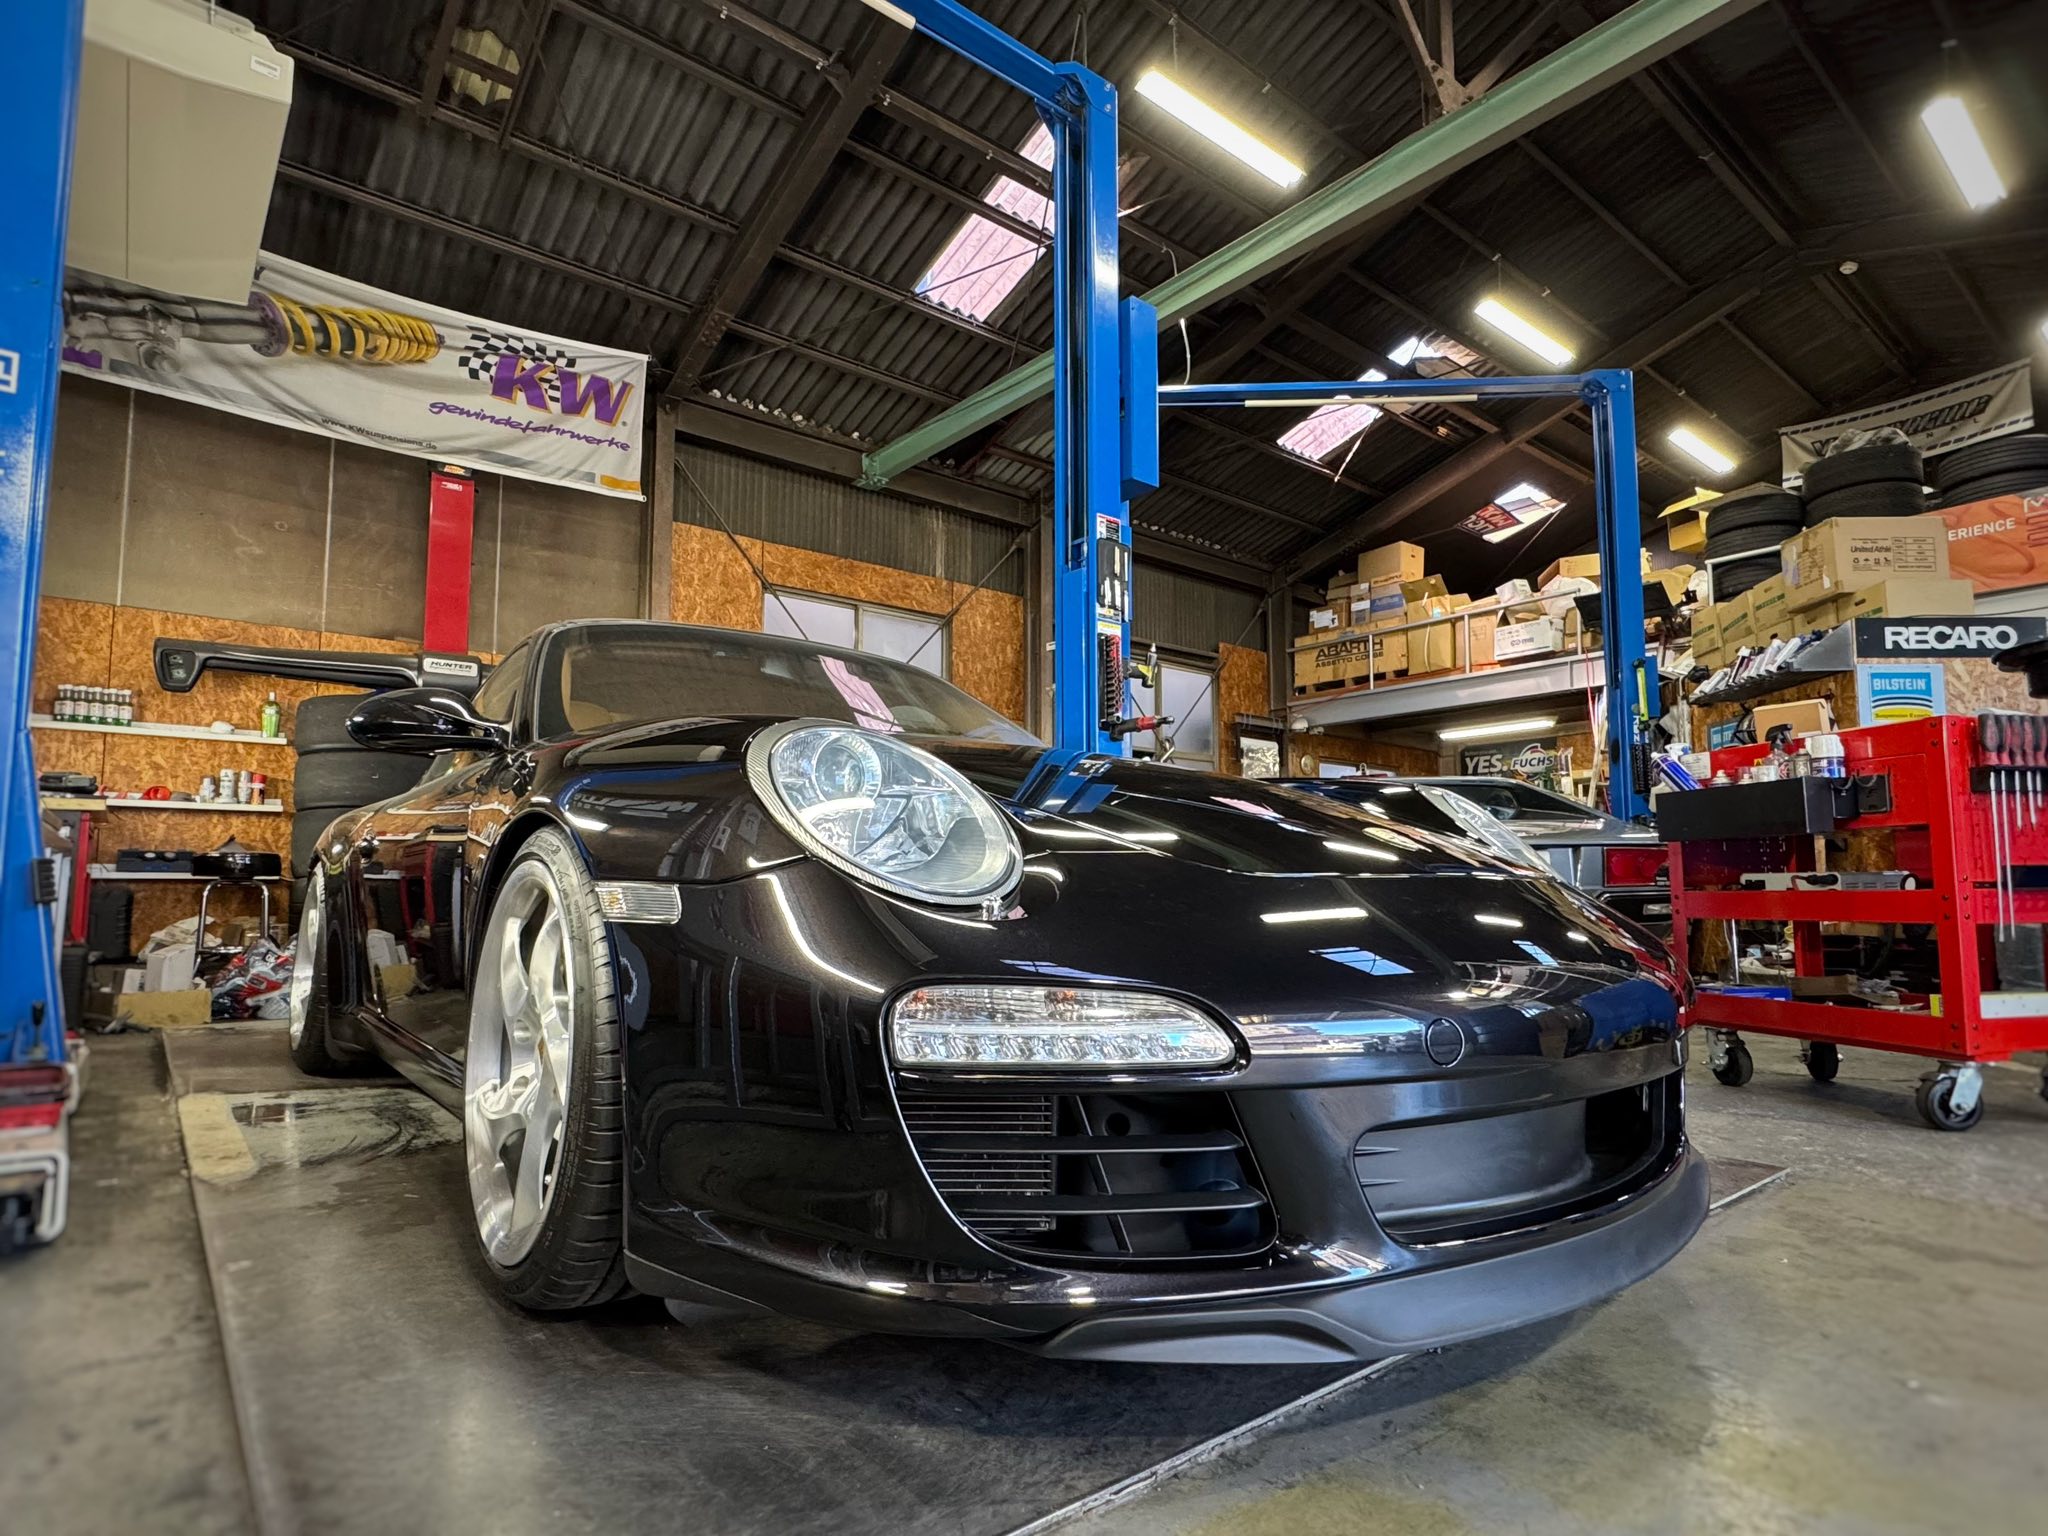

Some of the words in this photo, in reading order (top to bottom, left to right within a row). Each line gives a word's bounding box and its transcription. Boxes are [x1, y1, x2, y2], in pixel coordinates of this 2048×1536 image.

[491, 354, 635, 427] KW
[428, 400, 631, 452] gewindefahrwerke
[1947, 517, 2017, 542] ERIENCE
[1315, 638, 1384, 660] ABARTH
[1883, 625, 2019, 651] RECARO
[430, 661, 473, 671] HUNTER
[1872, 678, 1926, 691] BILSTEIN
[1465, 753, 1509, 775] YES.
[1512, 755, 1555, 769] FUCHS
